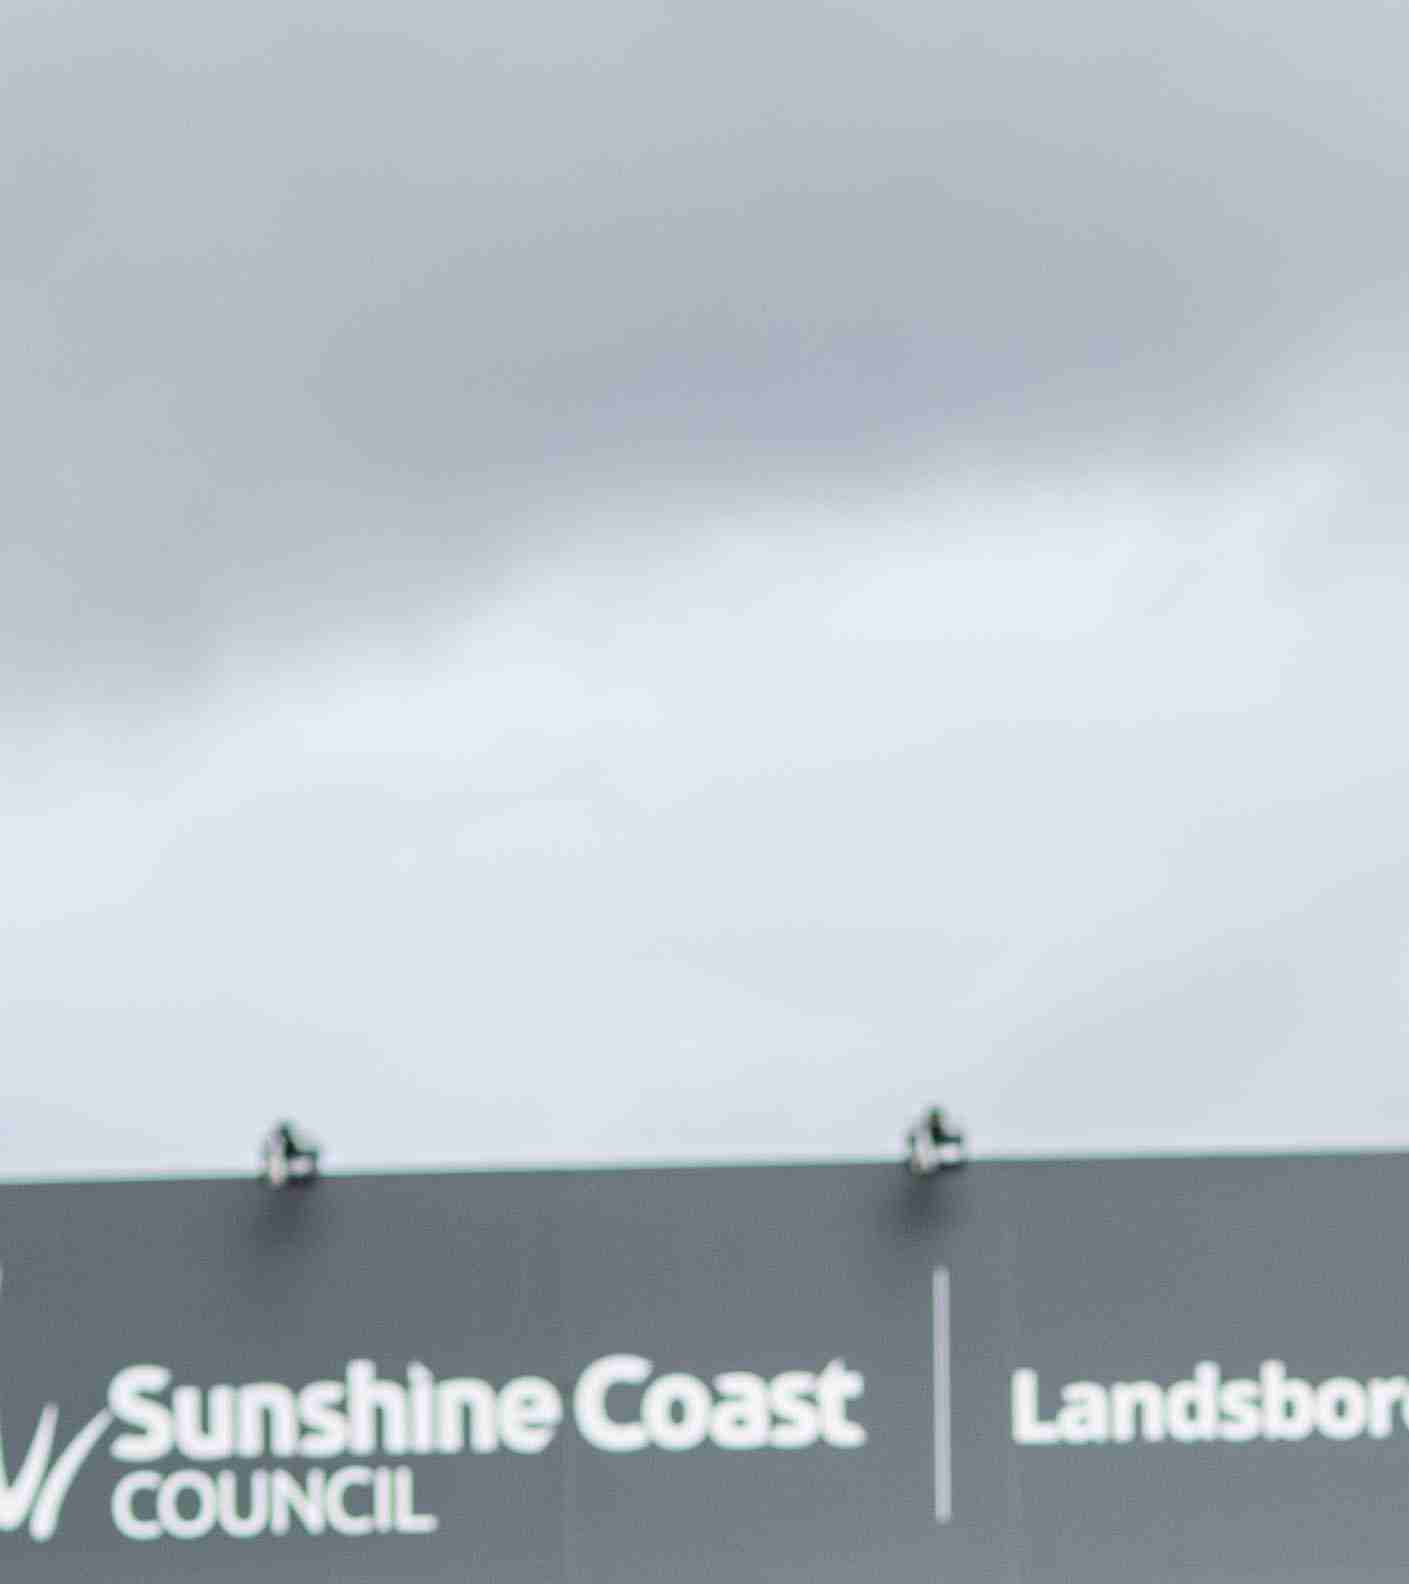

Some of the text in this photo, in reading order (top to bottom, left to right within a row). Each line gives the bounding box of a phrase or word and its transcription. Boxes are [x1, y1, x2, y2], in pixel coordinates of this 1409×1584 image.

[107, 1355, 868, 1462] Sunshine Coast
[110, 1467, 439, 1541] COUNCIL
